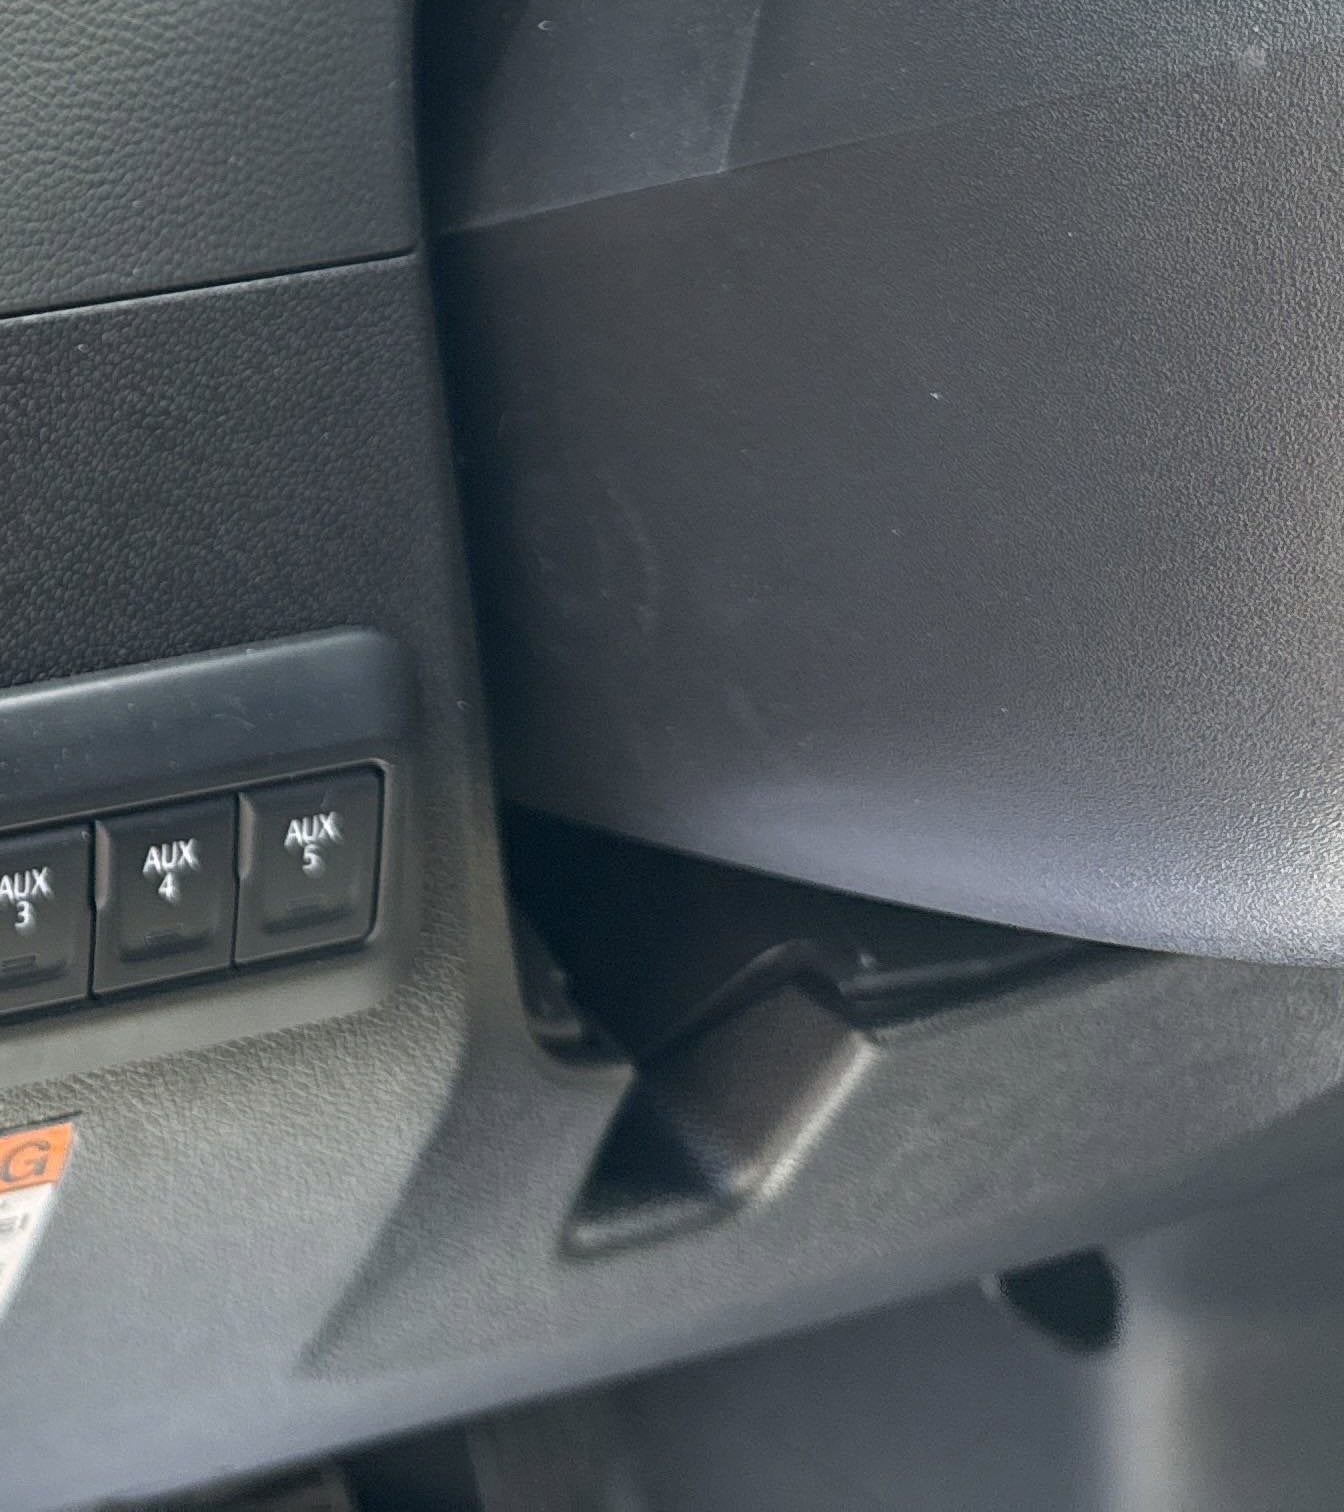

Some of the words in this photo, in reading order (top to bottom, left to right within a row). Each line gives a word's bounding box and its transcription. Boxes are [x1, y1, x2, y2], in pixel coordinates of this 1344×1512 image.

[284, 811, 342, 844] AUX
[142, 838, 199, 874] AUX
[302, 844, 322, 875] 5
[156, 873, 178, 902] 4
[15, 900, 35, 931] 3
